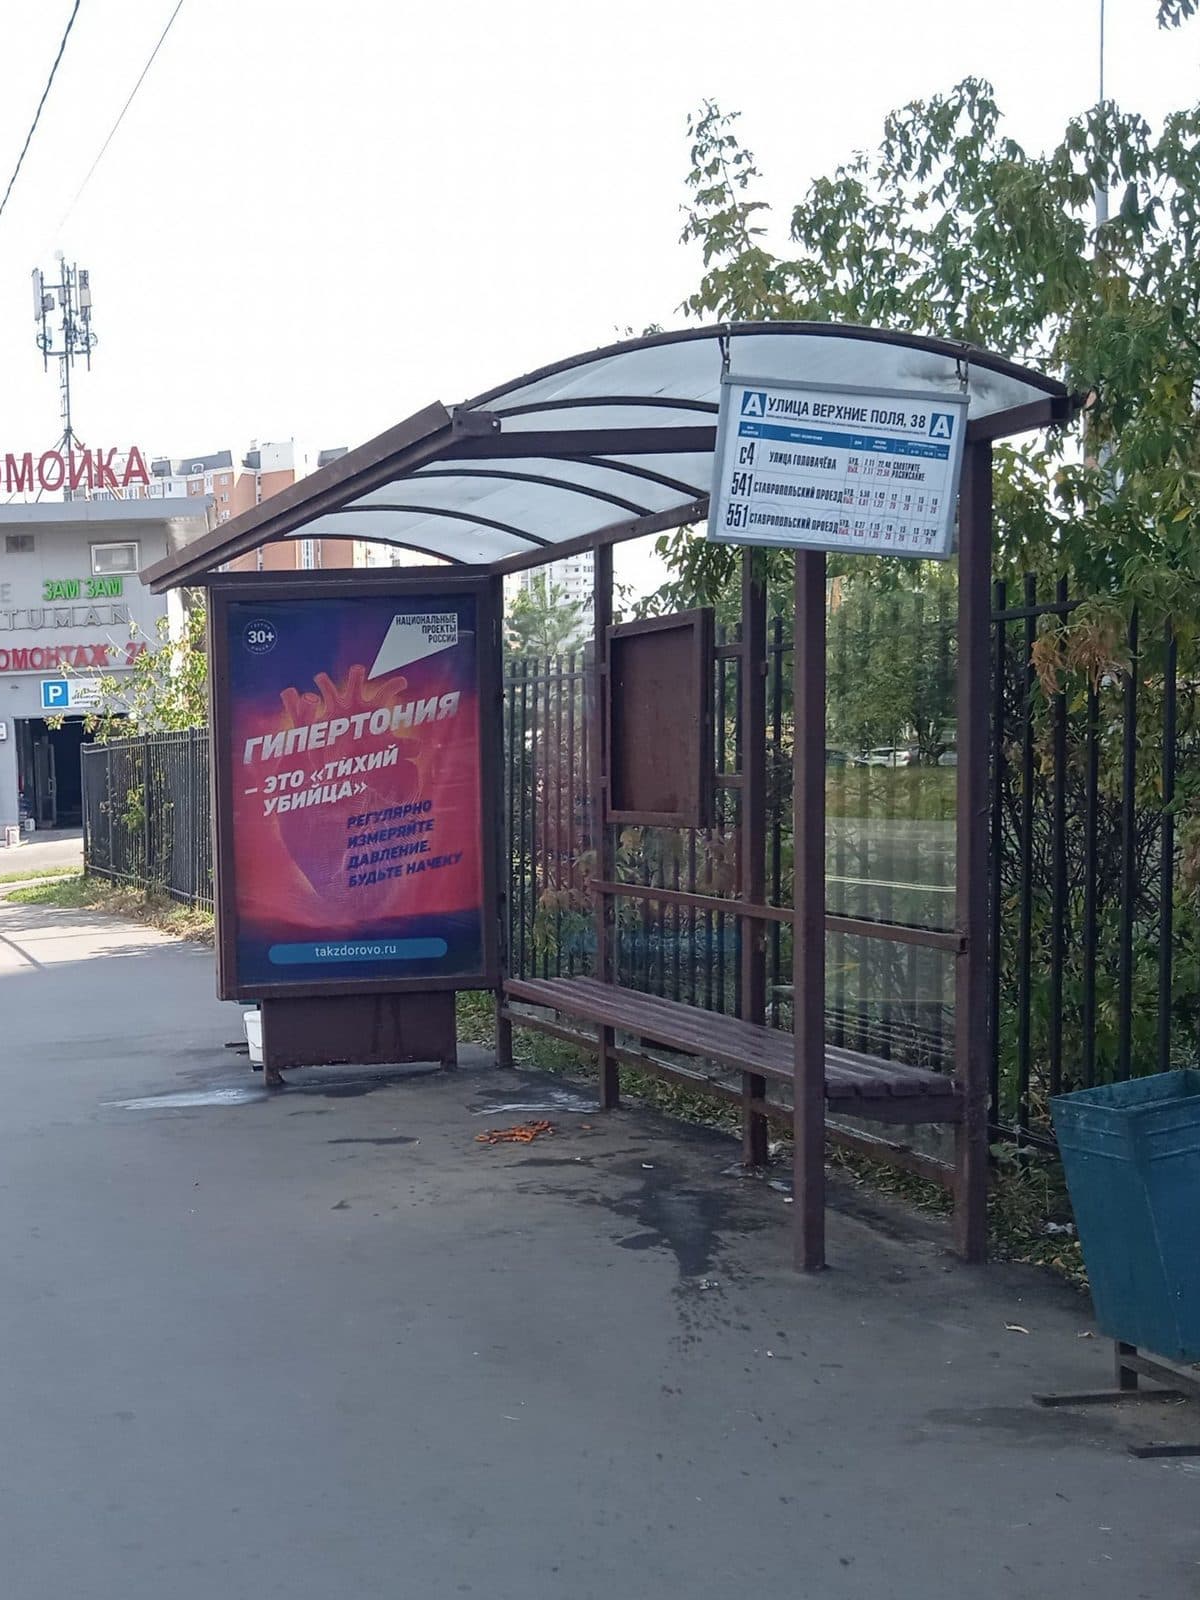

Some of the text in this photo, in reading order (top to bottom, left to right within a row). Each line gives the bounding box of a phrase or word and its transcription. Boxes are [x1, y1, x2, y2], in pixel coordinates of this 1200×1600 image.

[768, 397, 809, 417] УЛИЦА
[812, 402, 868, 422] ВЕРХНИЕ
[870, 409, 907, 428] ПОЛЯ,
[910, 414, 926, 429] 38
[769, 451, 792, 466] УЛИЦА
[731, 472, 753, 497] 541
[753, 481, 843, 503] СТАВРОПОЛЬСКИЙ ПРОЕЗД
[726, 503, 749, 528] 551
[749, 513, 839, 534] СТАВРОПОЛЬСКИЙ ПРОЕЗД
[42, 576, 123, 601] ЗАМ ЗАМ
[1, 604, 129, 631] TUMAN
[396, 614, 456, 625] НАЦИОНАЛЬНЫЕ
[422, 624, 456, 634] ПРОЕКТЫ
[248, 630, 275, 643] 30+
[428, 634, 456, 643] РОССИИ
[48, 685, 62, 704] P
[243, 691, 461, 764] ГИПЕРТОНИЯ
[263, 769, 305, 794] ЭТО
[310, 743, 399, 783] «ТИХИЙ
[263, 781, 368, 817] УБИЙЦА»
[347, 800, 432, 829] РЕГУЛЯРНО
[347, 818, 435, 849] ИЗМЕРЯЙТЕ
[346, 840, 431, 870] ДАВЛЕНИЕ.
[349, 852, 463, 888] БУДЬТЕ НАЧЕКУ
[315, 945, 397, 957] takzdorovo.ru
